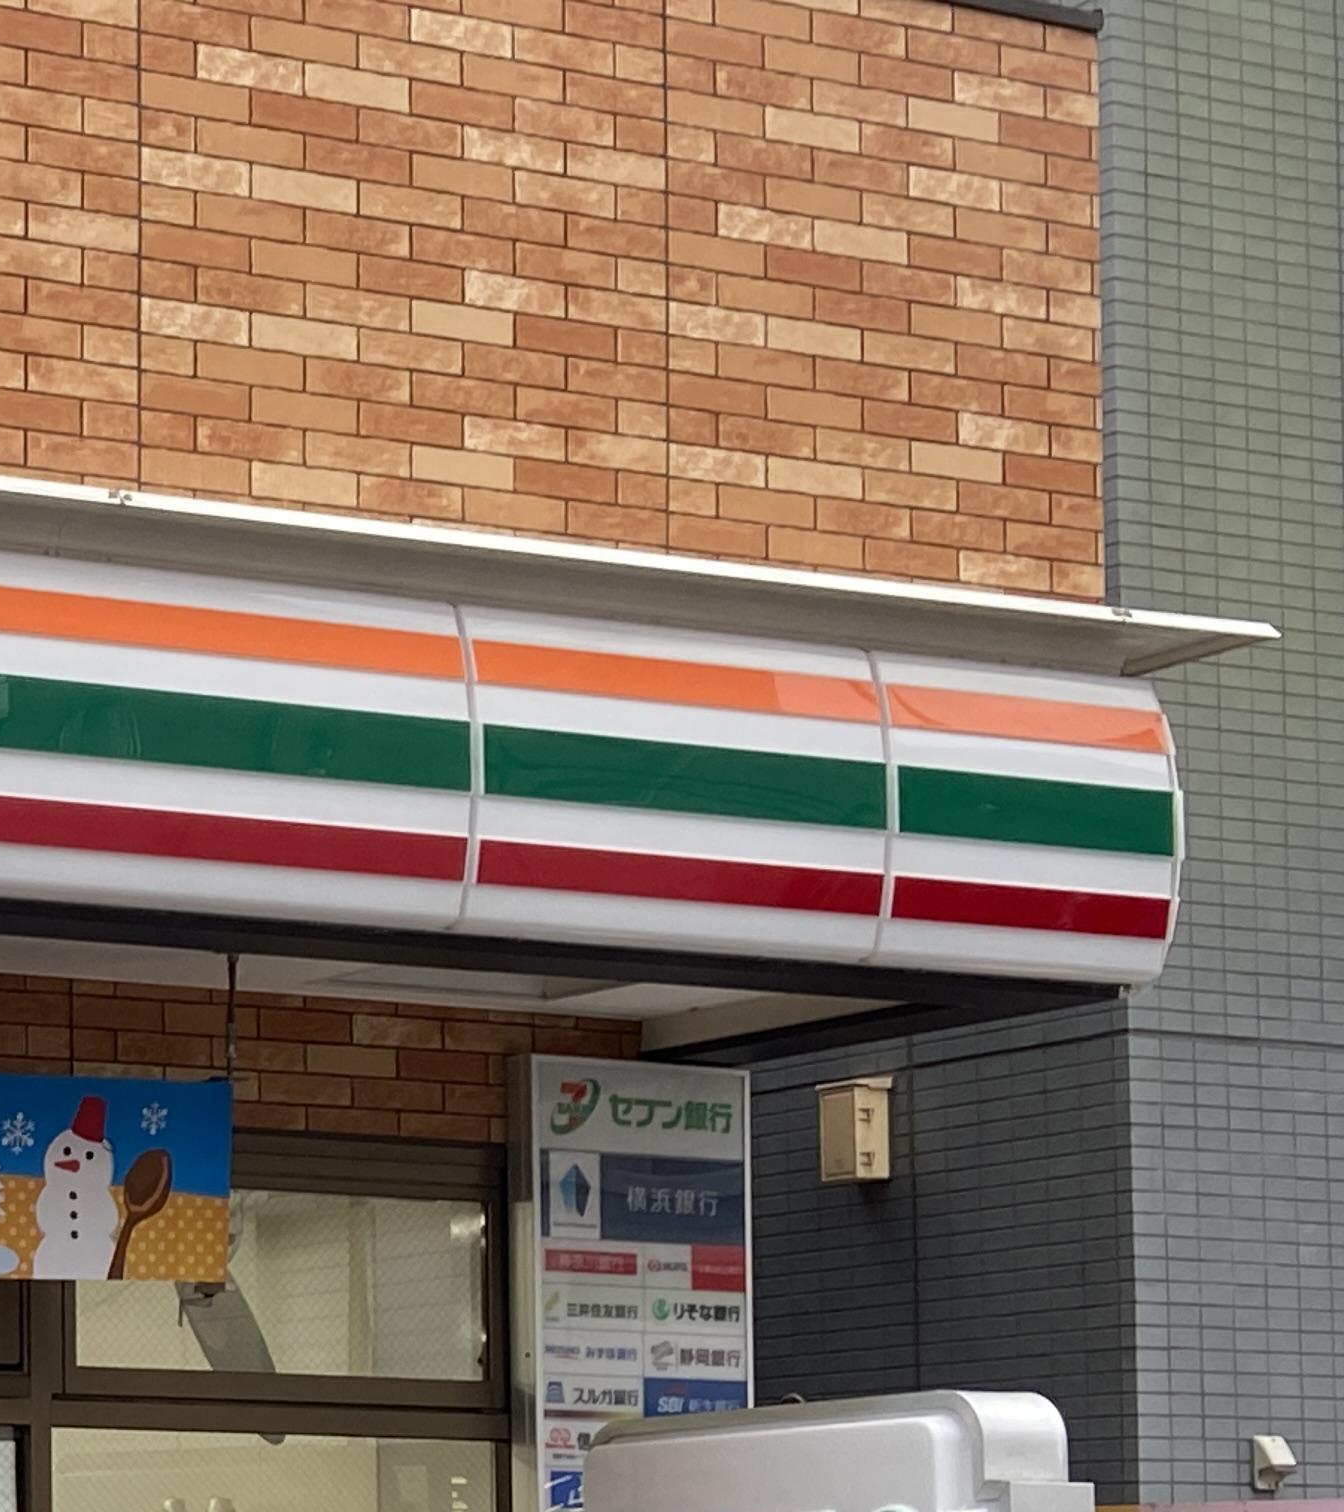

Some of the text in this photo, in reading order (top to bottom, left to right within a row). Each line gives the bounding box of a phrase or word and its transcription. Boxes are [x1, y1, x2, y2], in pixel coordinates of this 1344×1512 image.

[609, 1093, 733, 1134] セブン銀行
[626, 1185, 719, 1217] 横浜銀行
[673, 1303, 741, 1323] りそな銀行
[572, 1387, 639, 1406] スルガ銀行
